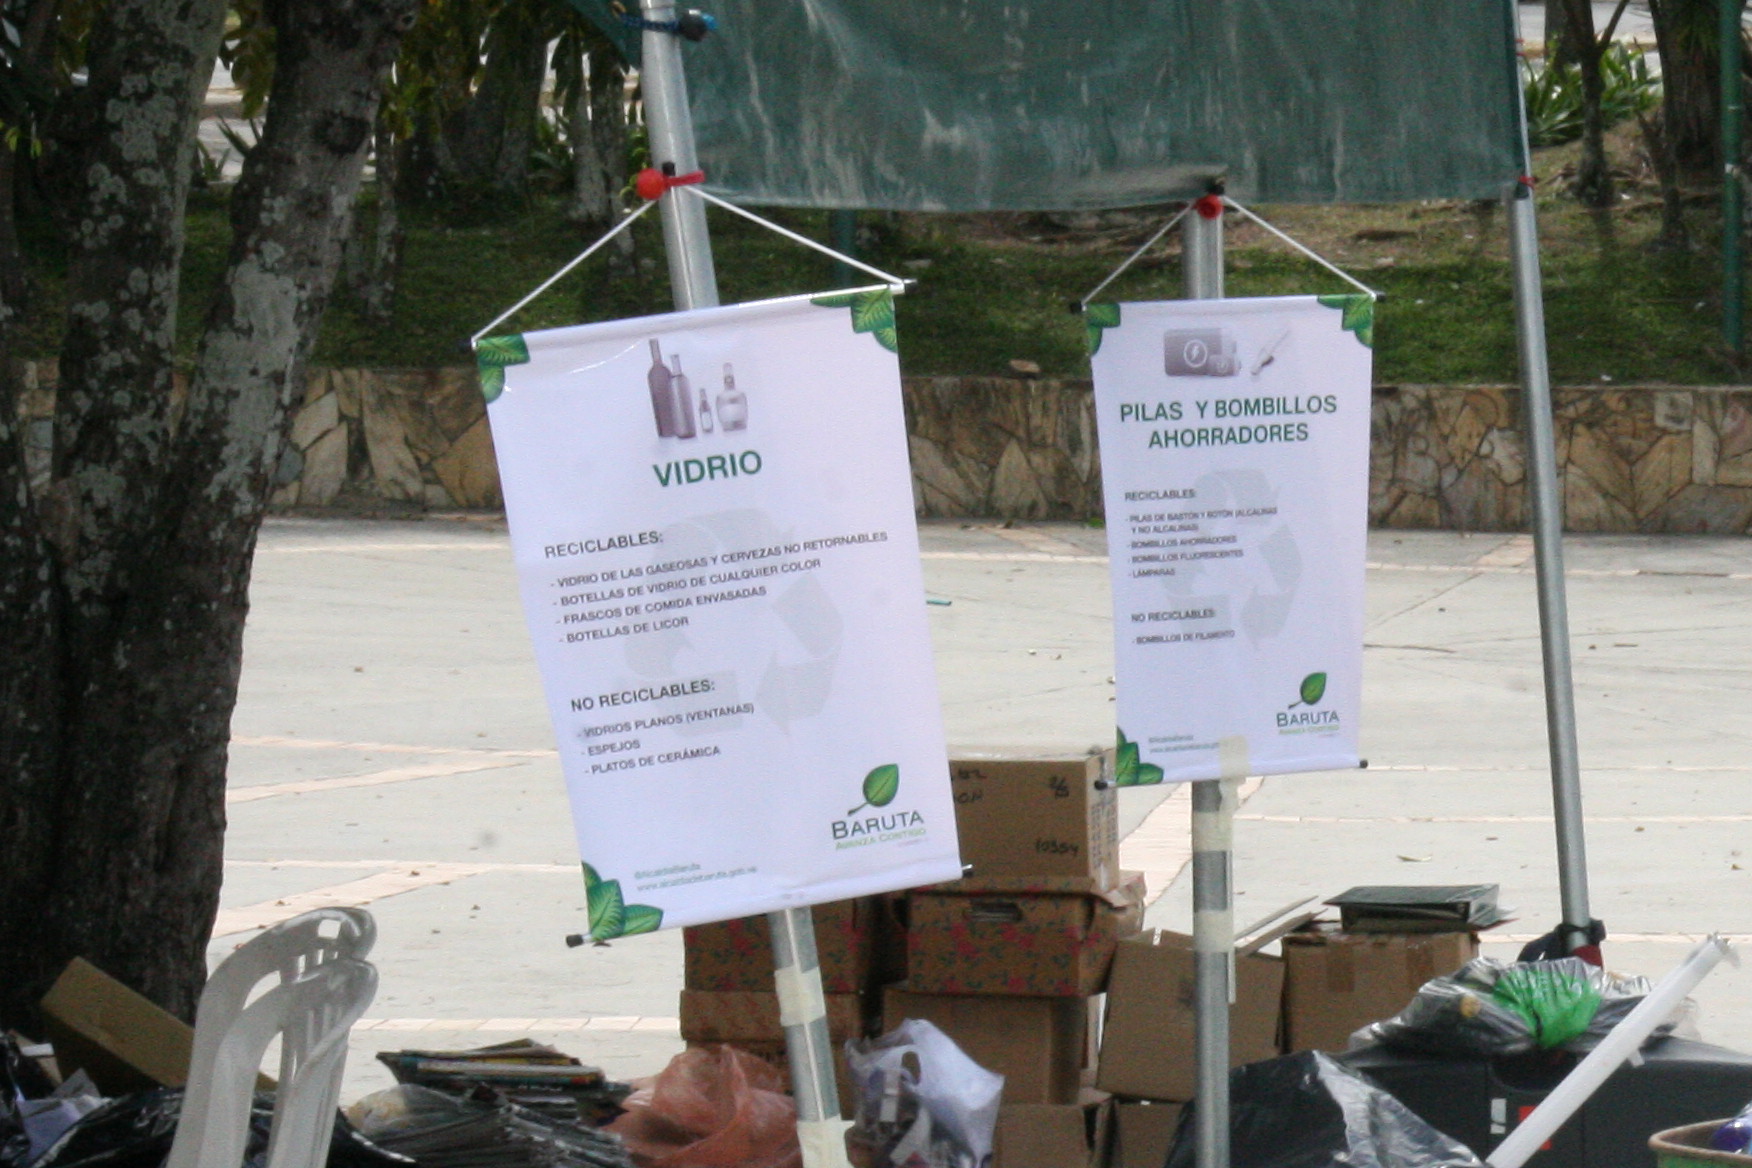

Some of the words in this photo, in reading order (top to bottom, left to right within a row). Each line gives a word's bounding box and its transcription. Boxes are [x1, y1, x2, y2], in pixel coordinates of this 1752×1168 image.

[1120, 402, 1183, 422] PILAS
[1195, 401, 1208, 419] Y
[1215, 395, 1338, 418] BOMBILLOS
[1148, 423, 1309, 449] AHORRADORES
[653, 450, 762, 487] VIDRIO
[544, 530, 665, 559] RECICLABLES:
[557, 571, 599, 588] VIDRIO
[601, 568, 617, 582] DE
[620, 565, 644, 579] LAS
[646, 556, 708, 576] GASEOSAS
[710, 555, 718, 566] Y
[721, 545, 782, 564] CERVEZAS
[783, 543, 801, 555] NO
[803, 531, 888, 551] RETORNABLES
[560, 588, 625, 607] BOTELLAS
[628, 585, 645, 598] DE
[647, 577, 687, 594] VIDRIO
[690, 575, 707, 588] DE
[709, 563, 779, 585] CUALQUIER
[781, 558, 821, 573] COLOR
[563, 607, 622, 626] FRASCOS
[625, 605, 641, 617] DE
[644, 597, 693, 613] COMIDA
[695, 585, 767, 605] ENVASADAS
[1131, 613, 1145, 622] NO
[566, 624, 630, 643] BOTELLAS
[632, 621, 649, 634] DE
[652, 615, 690, 631] LICOR
[571, 696, 595, 712] NO
[599, 679, 716, 708] RECICLABLES:
[583, 721, 632, 738] VIDRIOS
[634, 713, 683, 731] PLANOS
[686, 702, 755, 724] (VENTANAS)
[1276, 710, 1340, 727] BARUTA
[587, 739, 641, 757] ESPEJOS
[591, 757, 637, 774] PLATOS
[638, 755, 654, 768] DE
[657, 745, 721, 764] CERÁMICA
[831, 810, 925, 840] BARUTA
